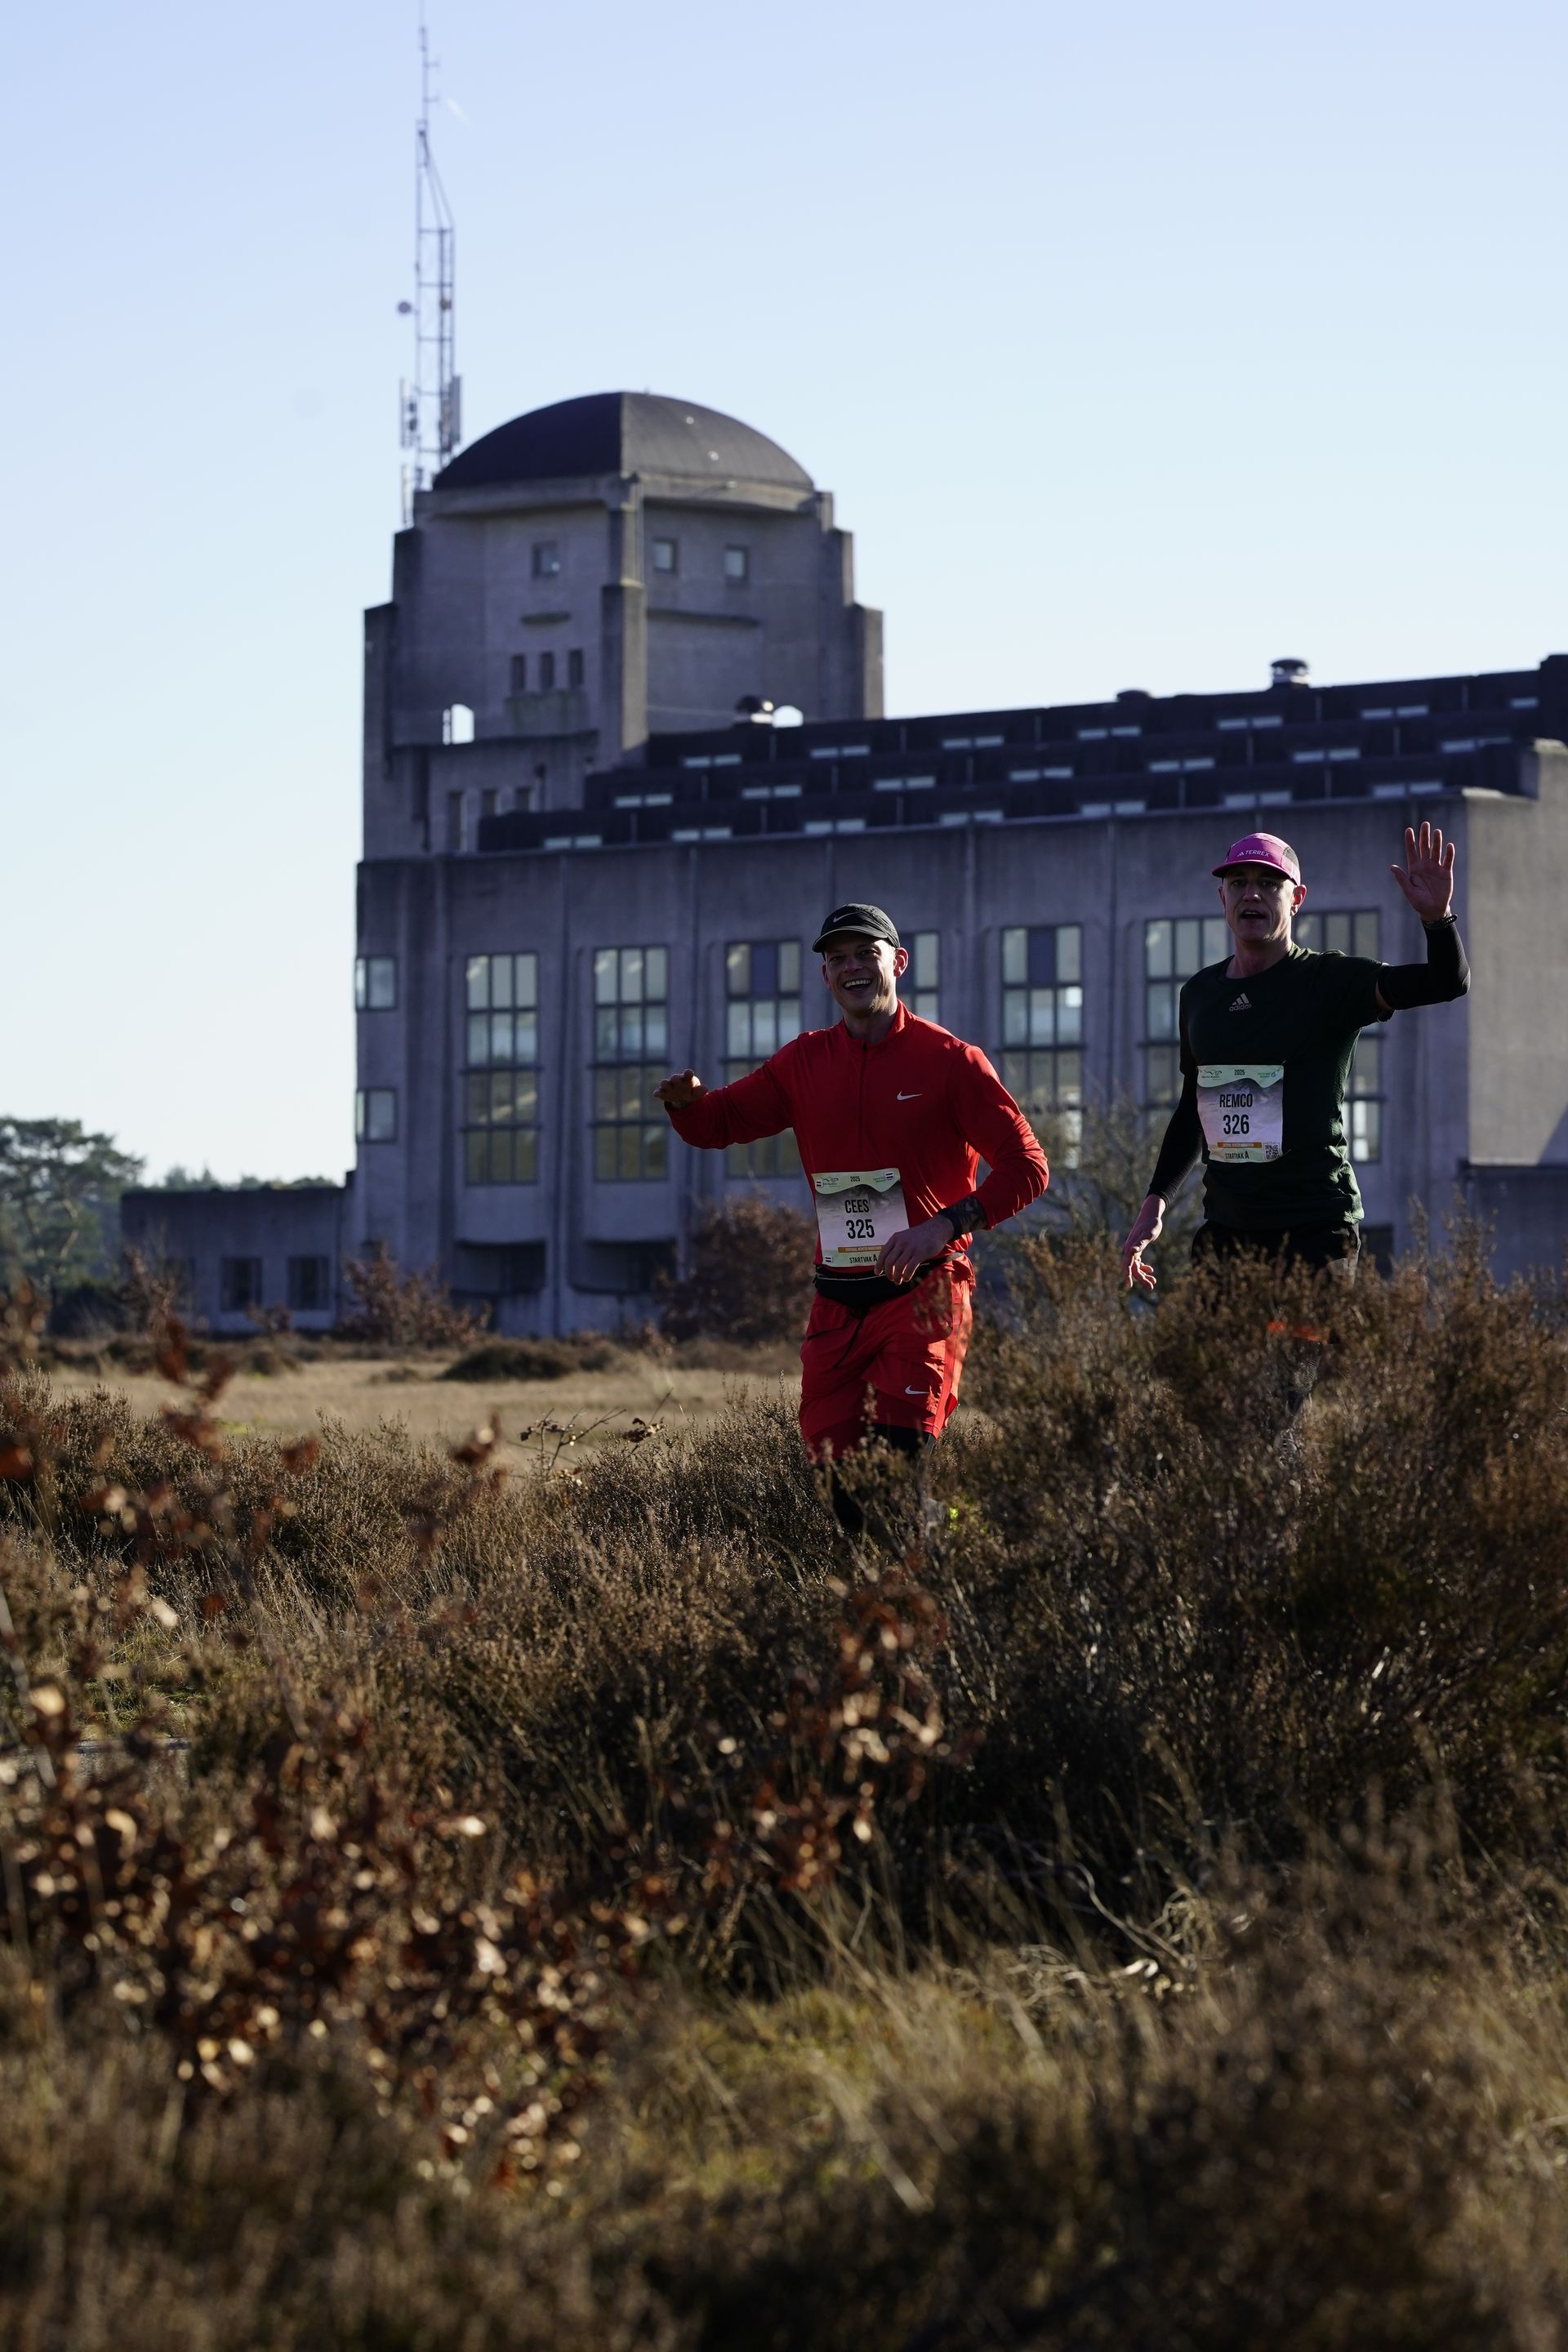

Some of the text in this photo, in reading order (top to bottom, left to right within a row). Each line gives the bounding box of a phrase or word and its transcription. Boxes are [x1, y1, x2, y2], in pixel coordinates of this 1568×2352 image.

[1219, 1094, 1253, 1108] REMCO
[1223, 1114, 1250, 1134] 326
[844, 1199, 870, 1214] CEES
[846, 1218, 875, 1239] 325
[873, 1254, 878, 1262] A
